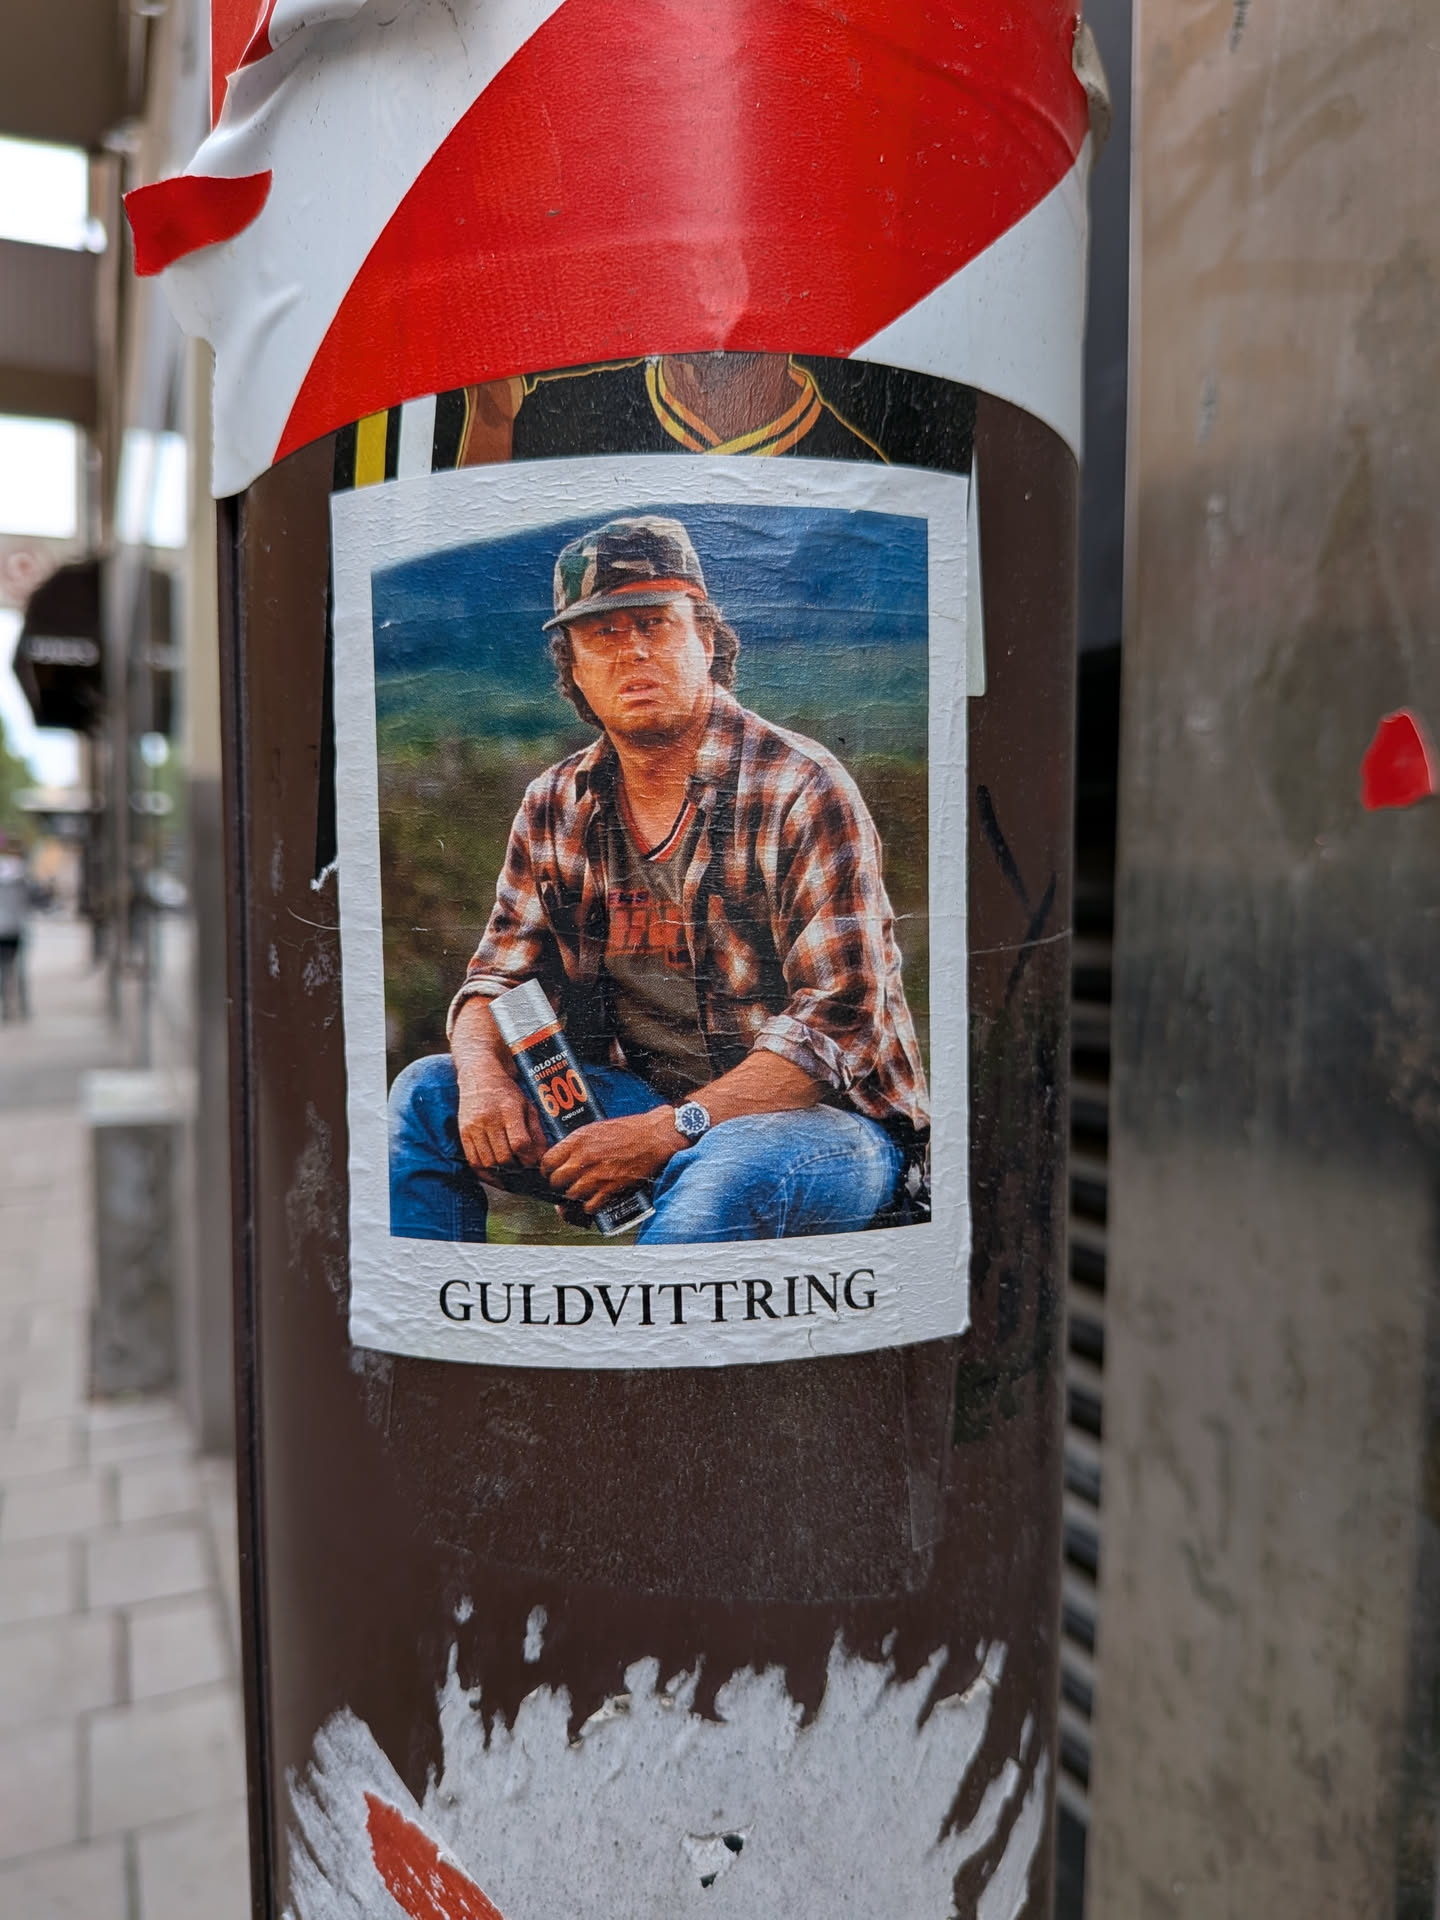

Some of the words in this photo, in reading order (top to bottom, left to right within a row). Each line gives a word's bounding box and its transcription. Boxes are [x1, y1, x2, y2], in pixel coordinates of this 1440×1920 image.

[528, 1050, 569, 1076] MOLOTOW
[538, 1069, 588, 1118] 600
[439, 1268, 877, 1327] GULDVITTRING
